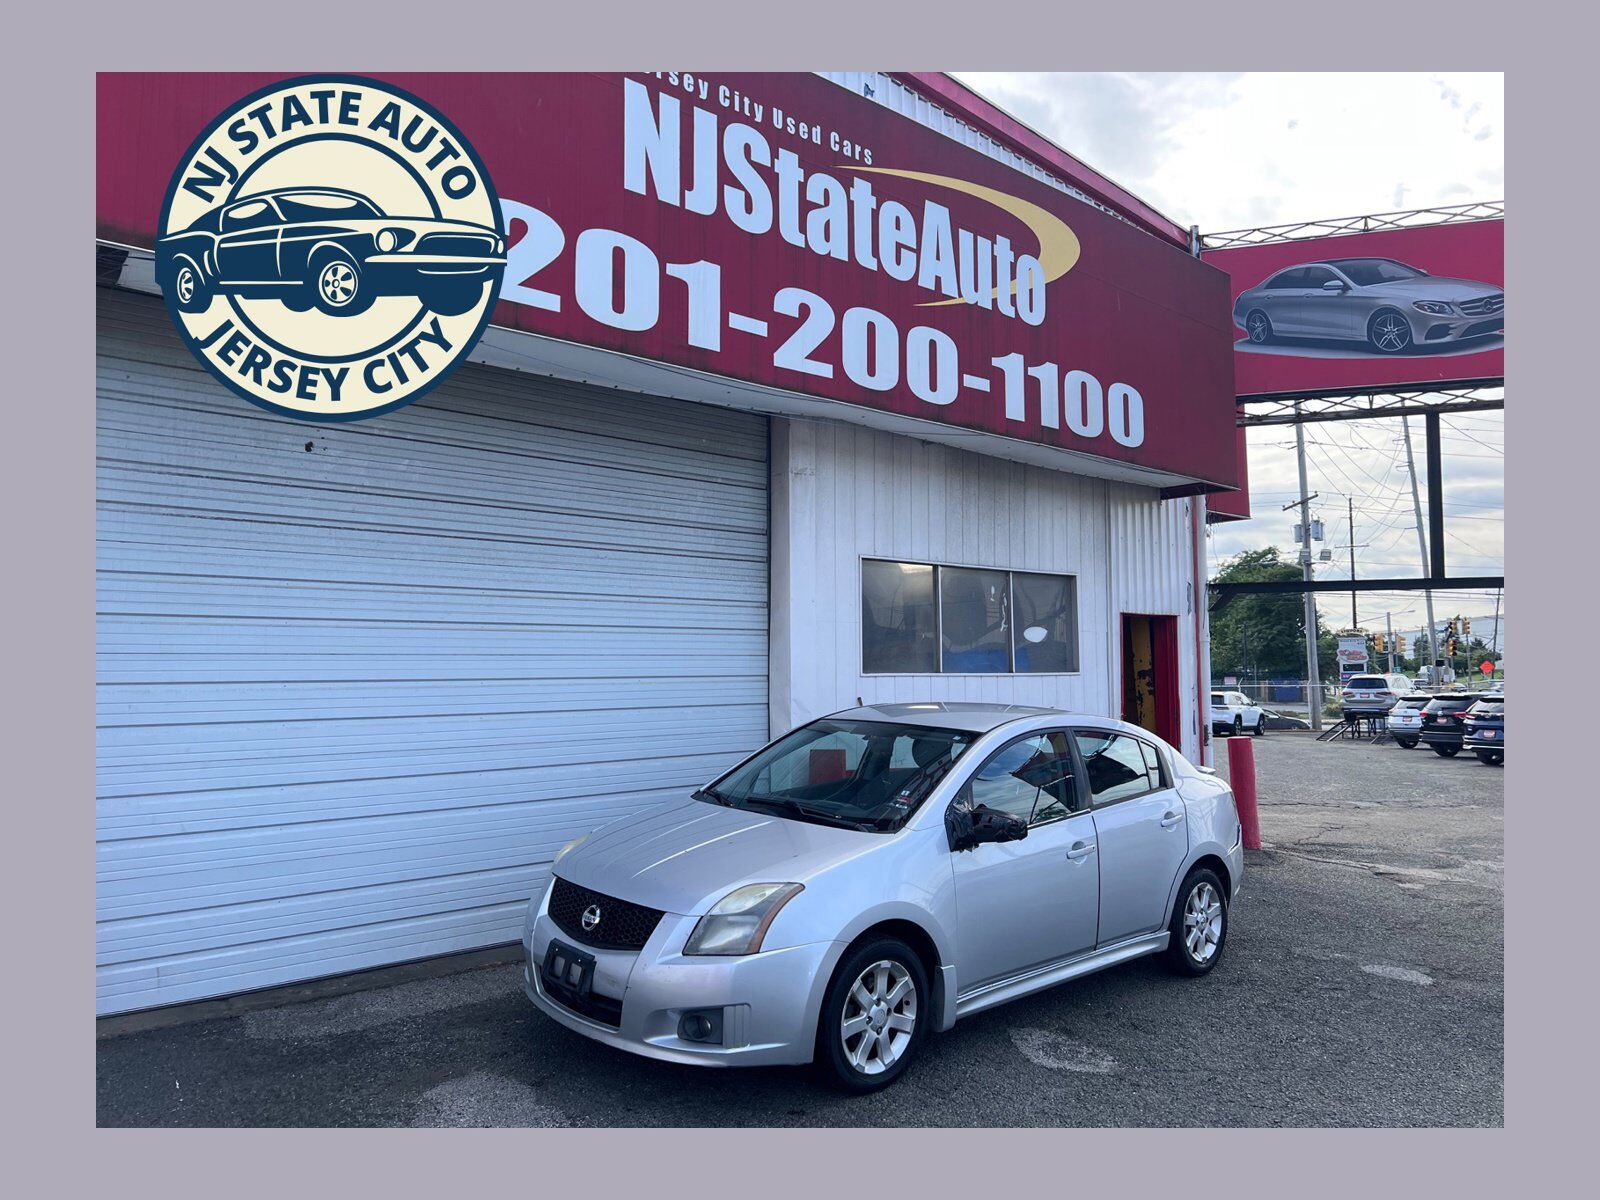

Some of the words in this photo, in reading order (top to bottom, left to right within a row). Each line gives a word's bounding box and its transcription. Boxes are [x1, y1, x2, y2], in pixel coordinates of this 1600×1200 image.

[623, 77, 1046, 326] NJStateAuto
[718, 84, 764, 122] City
[772, 107, 821, 145] Used
[830, 131, 872, 165] Cars
[497, 197, 1145, 448] 201-200-1100
